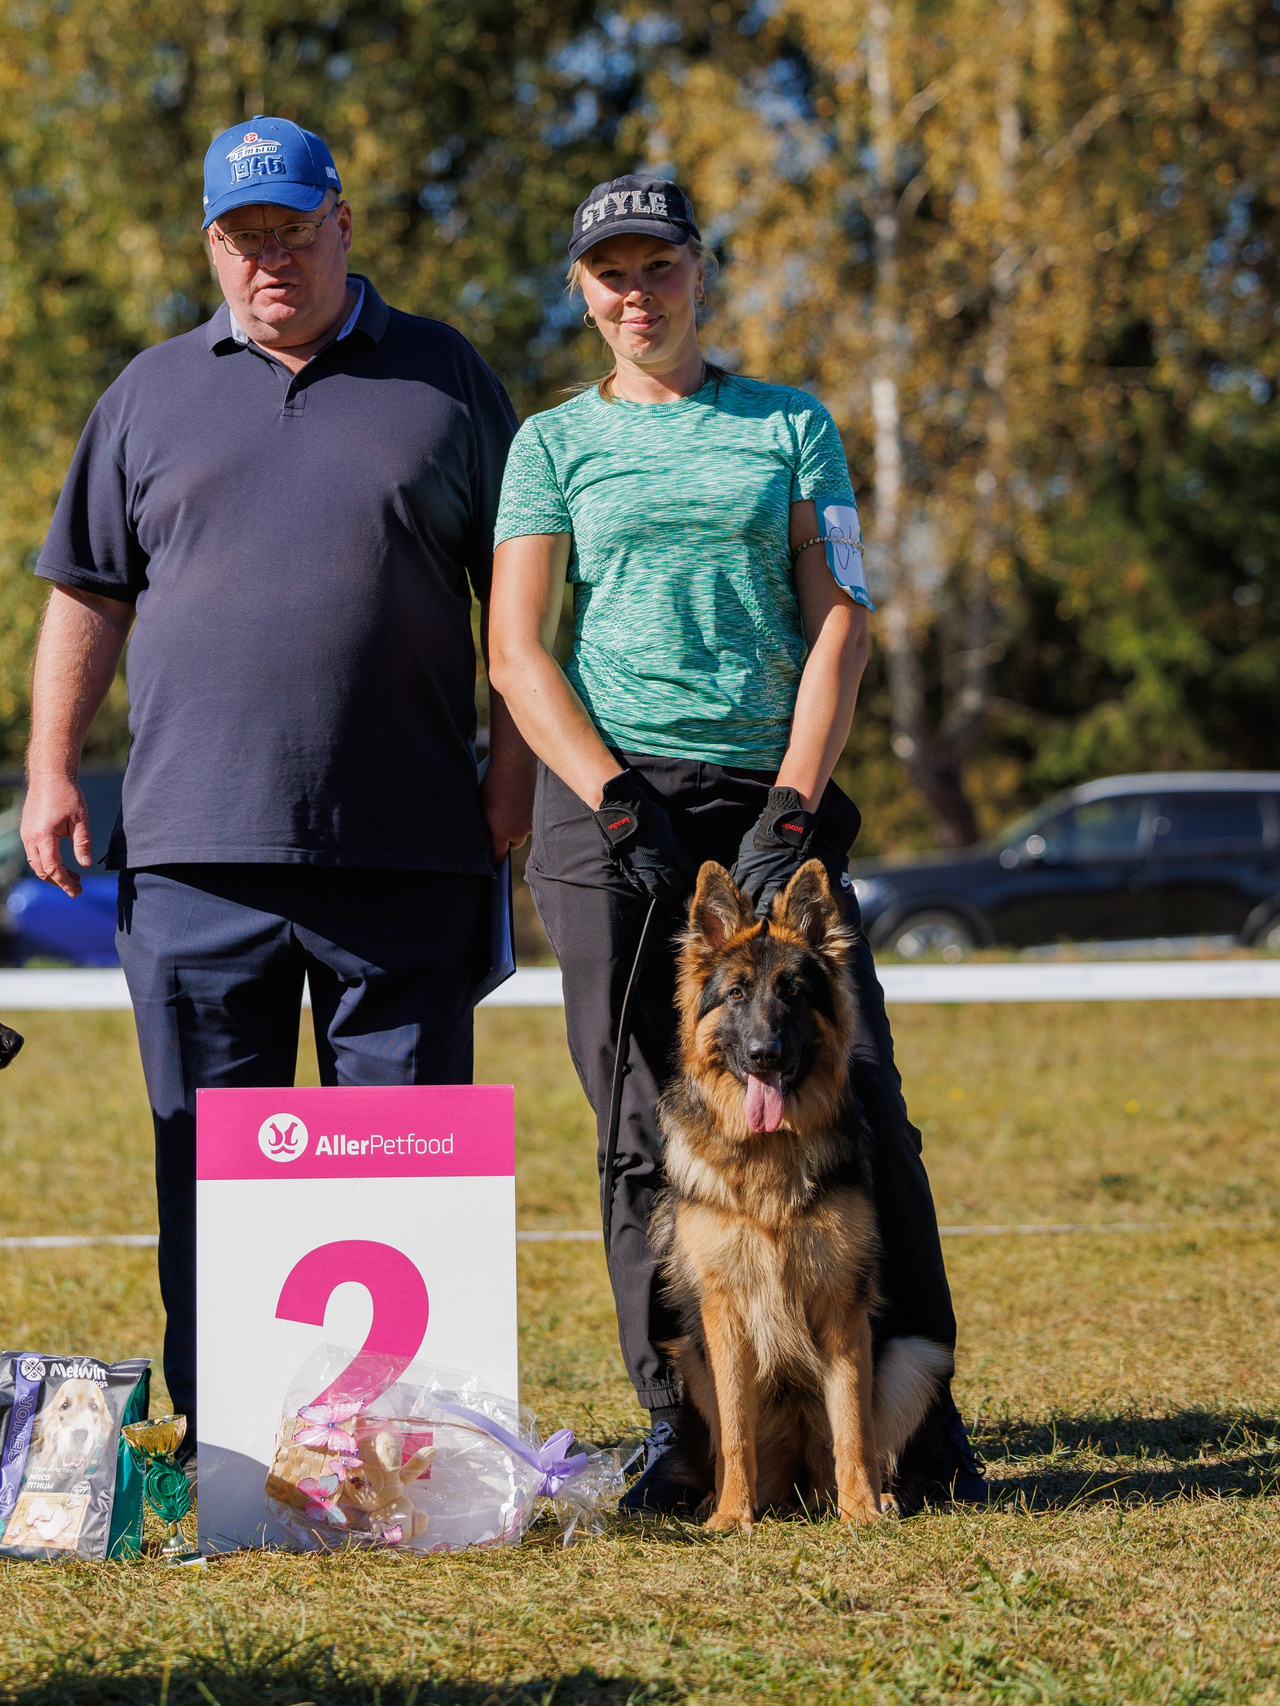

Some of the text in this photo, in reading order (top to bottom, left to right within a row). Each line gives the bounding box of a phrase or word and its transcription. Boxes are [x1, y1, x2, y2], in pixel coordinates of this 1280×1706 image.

[230, 155, 286, 184] 1946
[581, 190, 668, 232] STYLE
[315, 1133, 454, 1156] AllerPetfood
[275, 1239, 433, 1479] 2
[50, 1362, 106, 1380] Melwin
[90, 1379, 108, 1388] dogs
[8, 1394, 34, 1464] SENIOR
[27, 1482, 55, 1490] ПТИЦЫ
[29, 1473, 51, 1481] МЯСО
